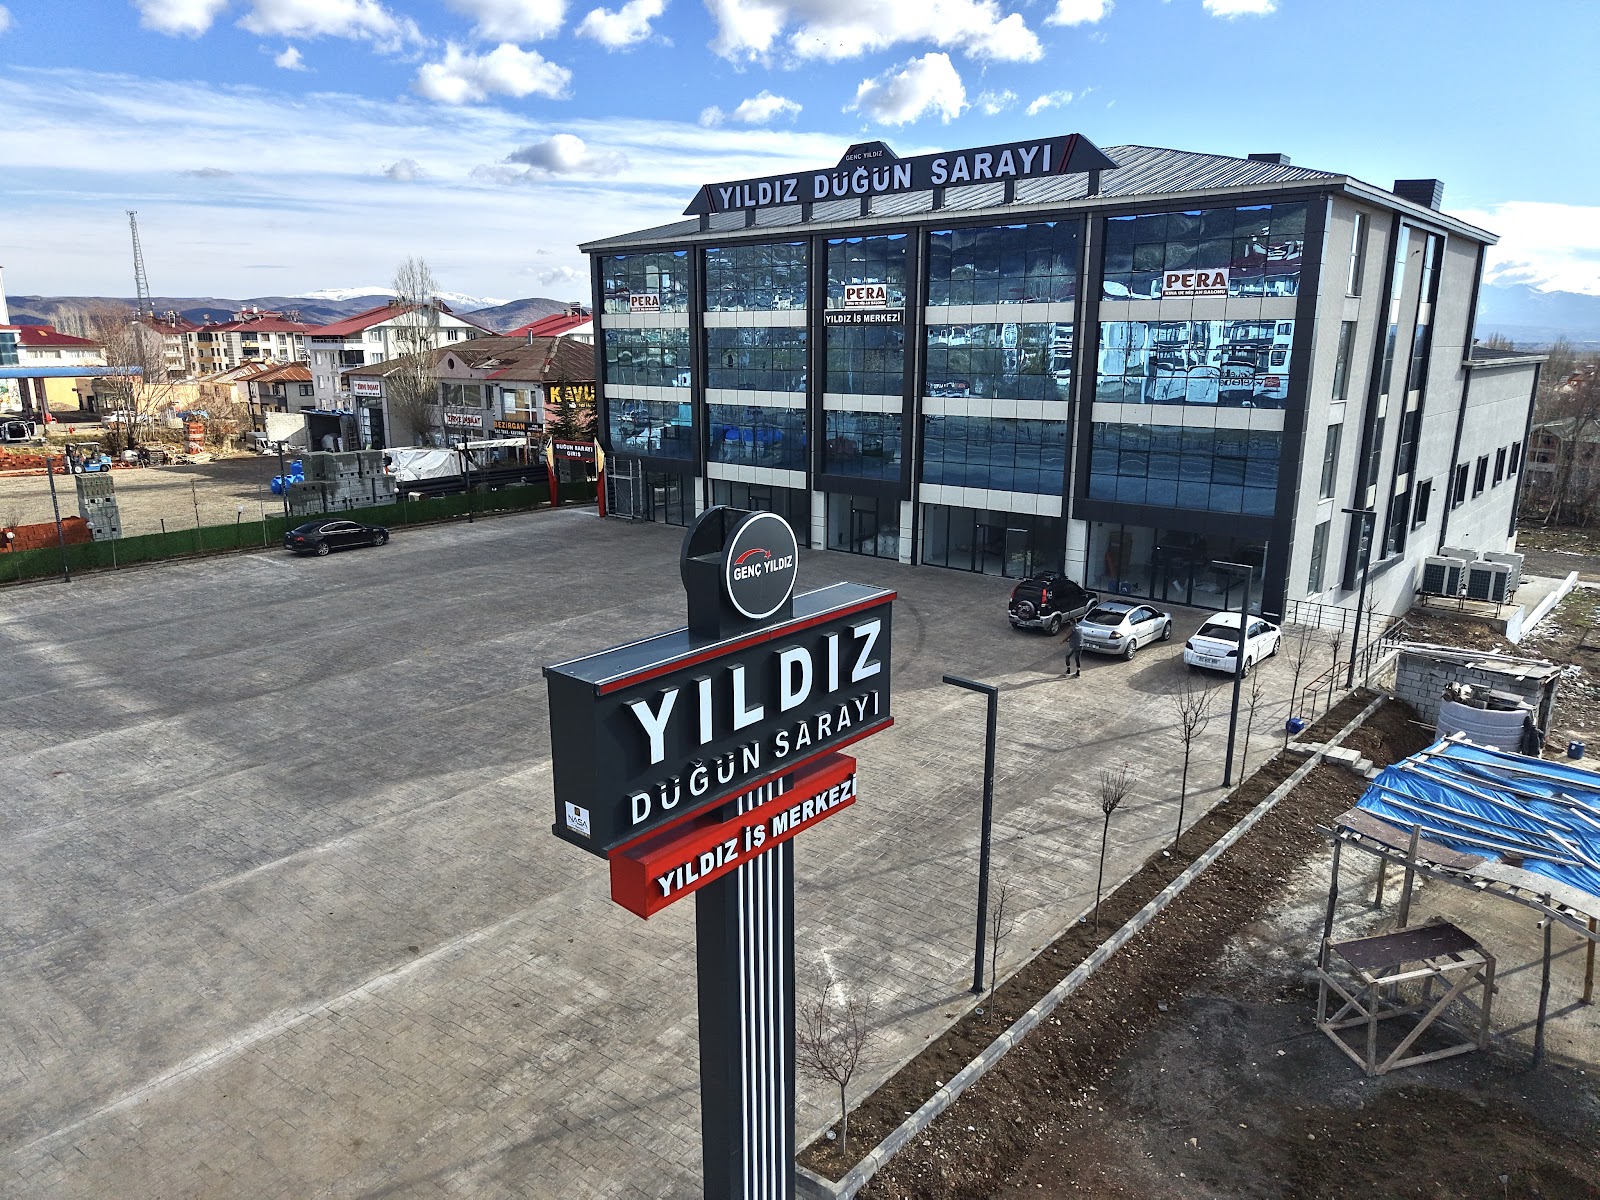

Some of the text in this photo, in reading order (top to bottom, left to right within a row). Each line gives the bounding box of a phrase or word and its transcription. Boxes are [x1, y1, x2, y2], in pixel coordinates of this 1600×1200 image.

[863, 150, 883, 159] YILDIZ
[718, 144, 1053, 209] YILDIZ DÜĞÜN SARAYI
[1166, 271, 1227, 288] PERA
[631, 295, 659, 307] PERA
[846, 286, 885, 300] PERA
[825, 311, 901, 323] YILDIZ İŞ MERKEZİ
[493, 420, 526, 430] BEZİRGAN
[733, 554, 793, 581] GENÇ YILDIZ
[627, 617, 882, 765] YILDIZ
[629, 689, 880, 826] DÜĞÜN SARAYI
[567, 813, 588, 828] NASA
[656, 773, 857, 898] YILDIZ İŞ MERKEZİ
